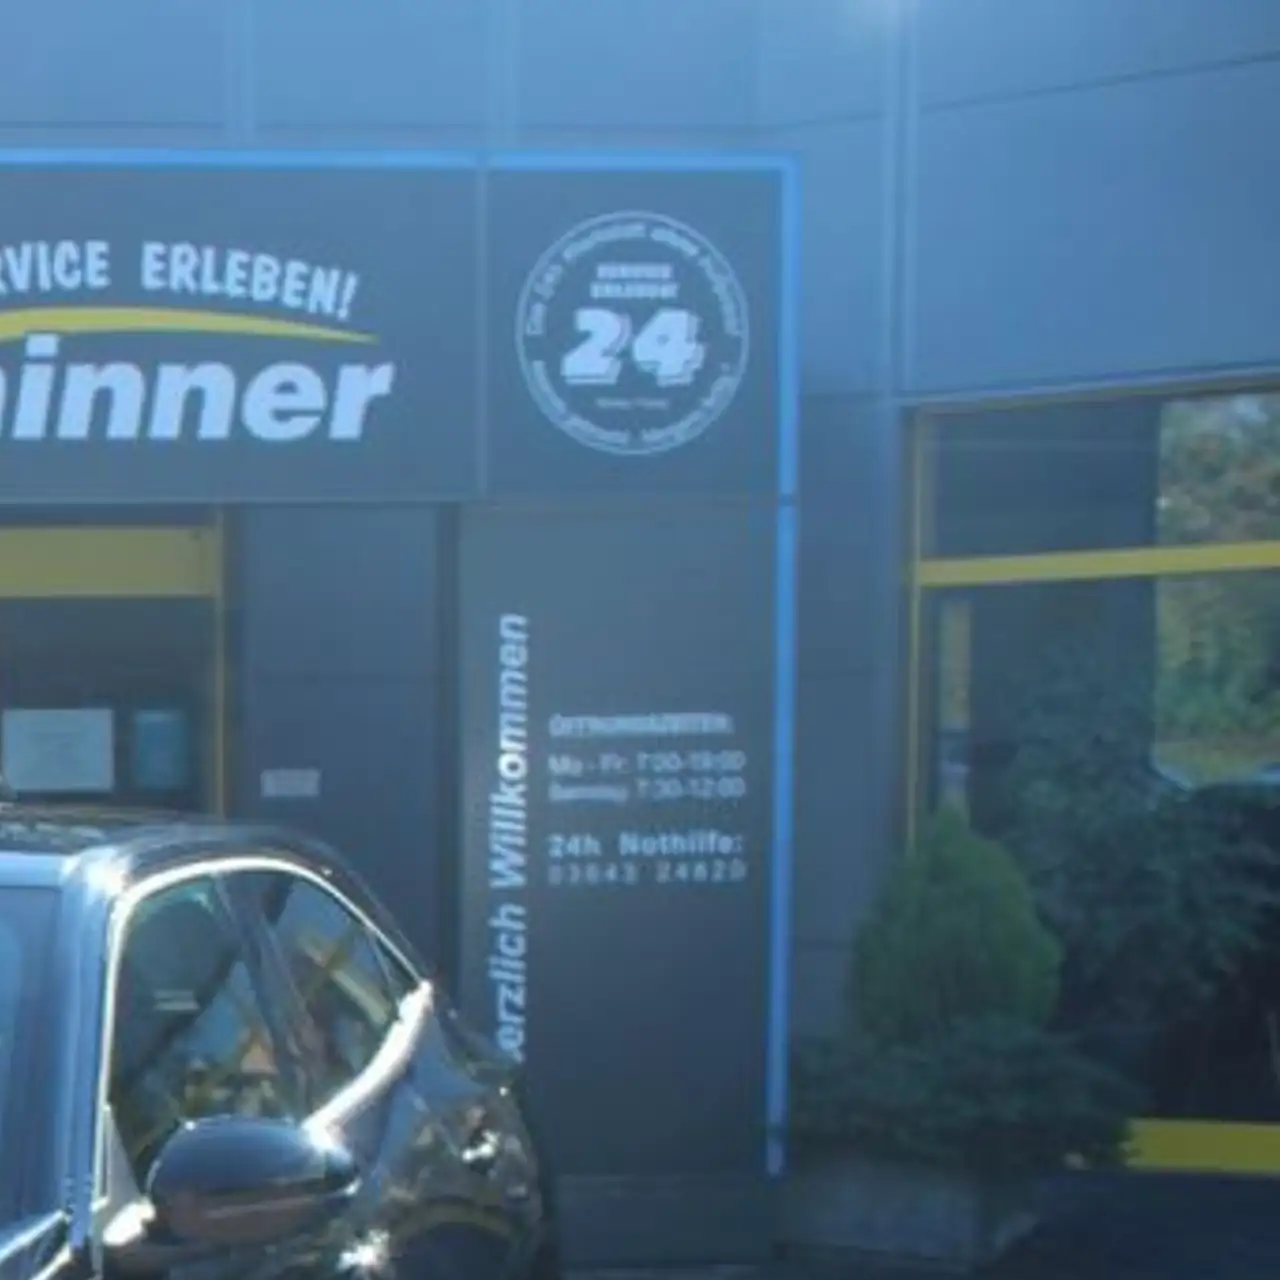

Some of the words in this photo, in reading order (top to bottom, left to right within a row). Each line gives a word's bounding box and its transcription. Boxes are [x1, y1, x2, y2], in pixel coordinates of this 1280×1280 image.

[140, 241, 359, 320] ERLEBEN!
[559, 306, 706, 388] 24
[489, 613, 528, 889] Willkommen
[548, 833, 602, 857] 24h
[489, 903, 527, 1064] erzlich
